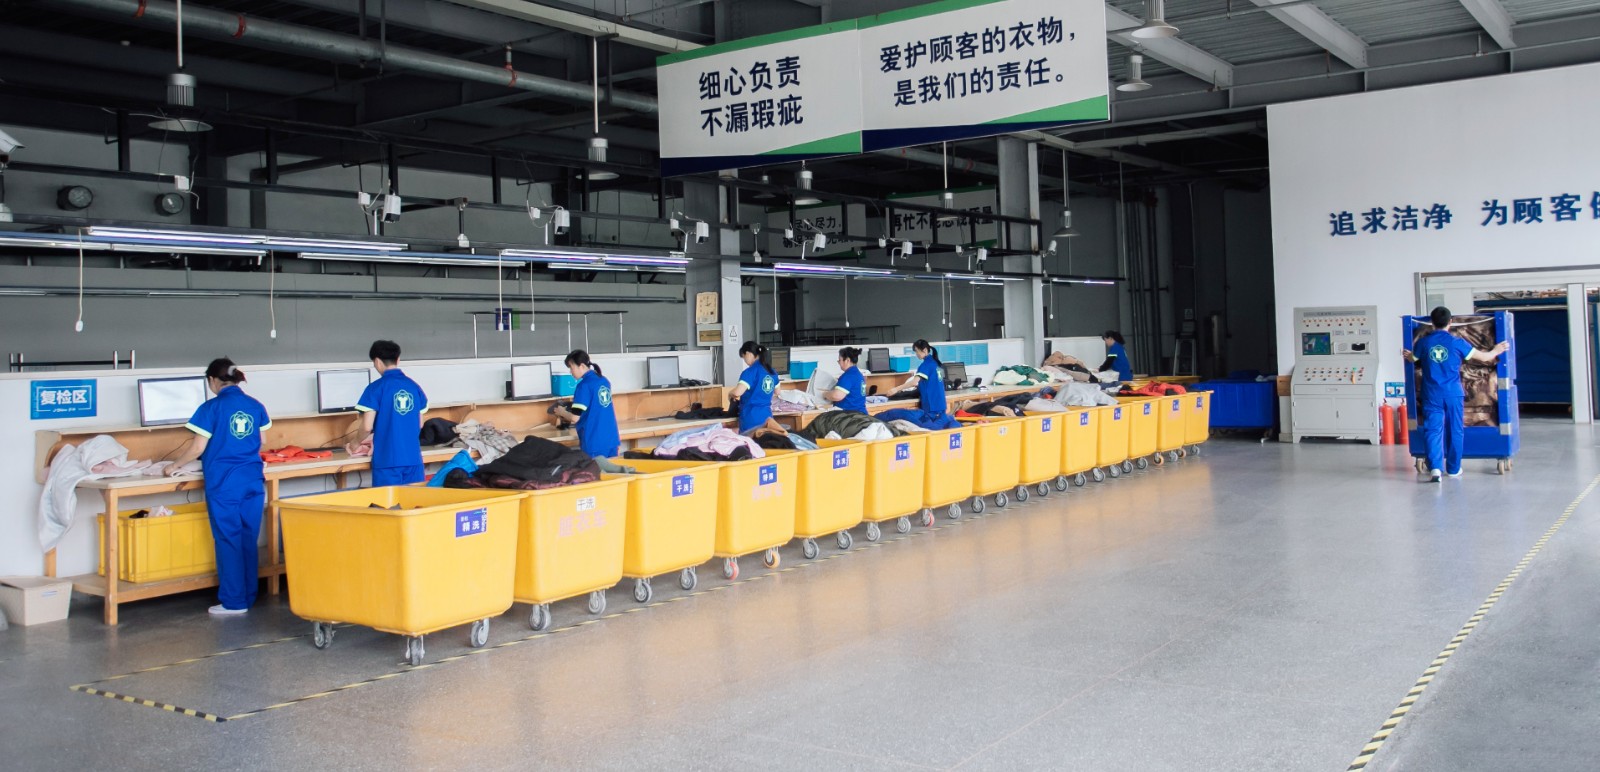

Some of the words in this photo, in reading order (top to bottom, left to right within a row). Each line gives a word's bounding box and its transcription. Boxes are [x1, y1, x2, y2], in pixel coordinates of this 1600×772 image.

[879, 16, 1077, 74] 爱护顾客的衣物，
[699, 55, 802, 100] 细心负责
[893, 57, 1066, 108] 是我们的责任。
[700, 95, 804, 137] 不漏瑕疵
[1329, 203, 1453, 237] 追求洁净
[40, 389, 88, 406] 复检区
